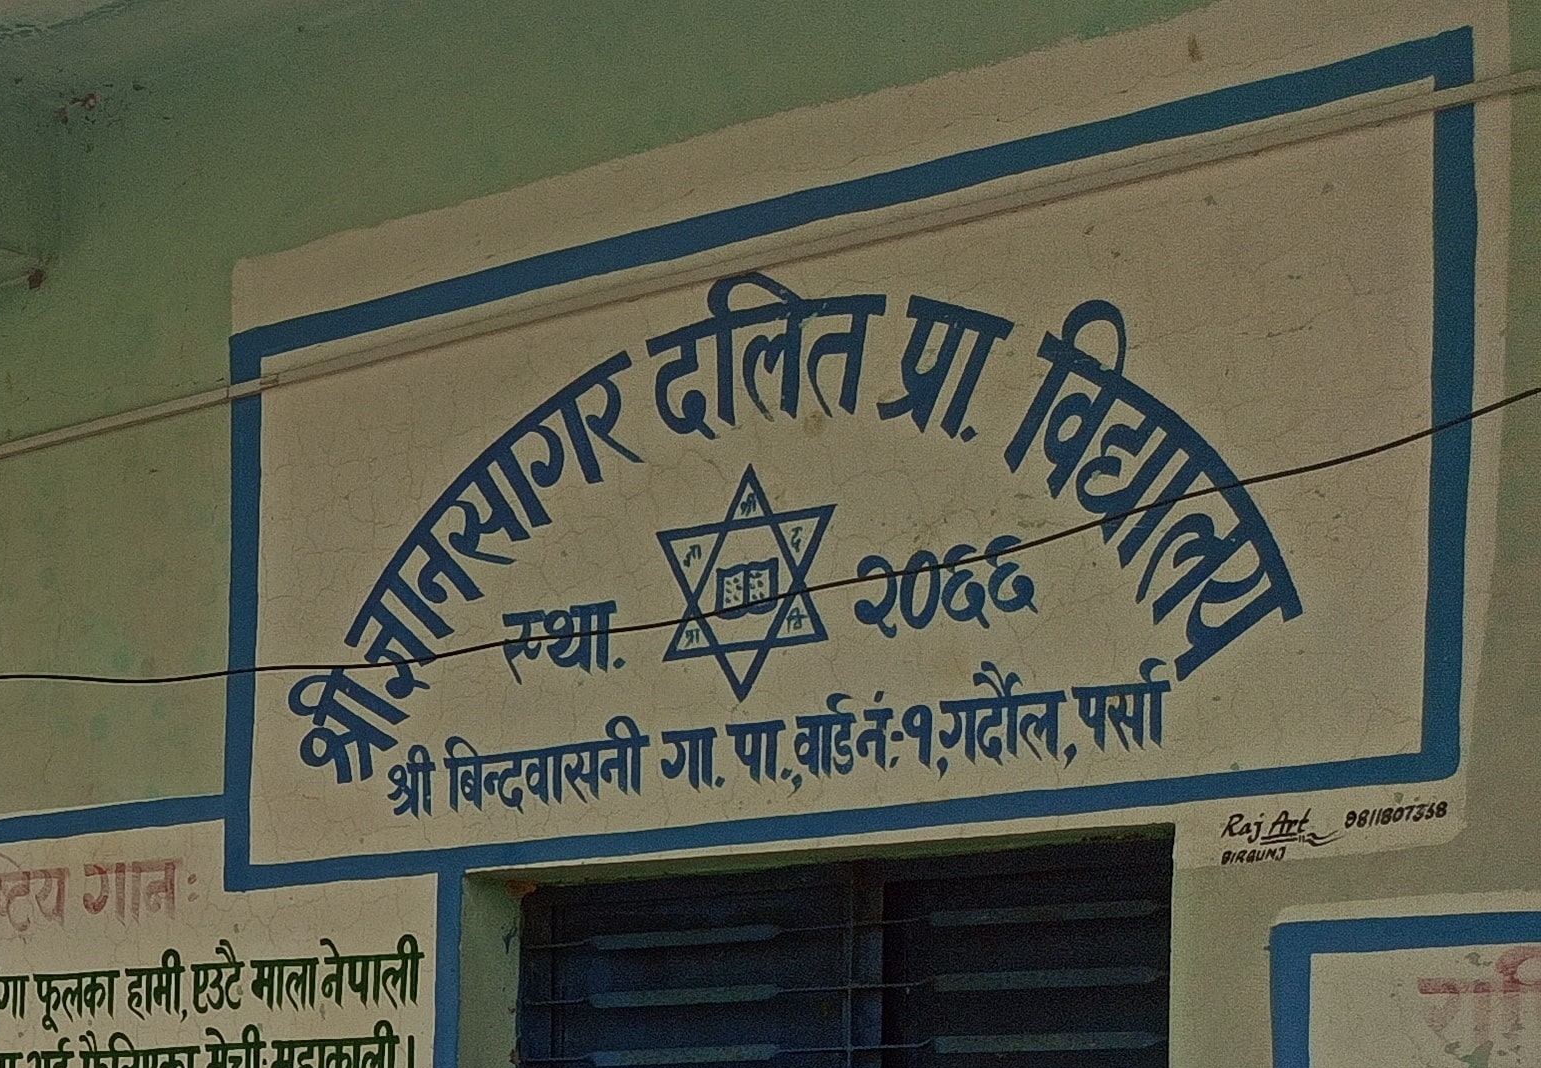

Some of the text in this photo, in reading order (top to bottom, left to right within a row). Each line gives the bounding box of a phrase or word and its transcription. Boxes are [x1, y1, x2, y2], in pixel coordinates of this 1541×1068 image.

[646, 271, 888, 441] दलित
[876, 294, 1016, 444] प्रा.
[1004, 299, 1304, 682] विद्यालय
[502, 535, 1038, 685] स्था. २०६६
[387, 744, 437, 820] श्री
[660, 726, 727, 795] गा.
[1071, 656, 1173, 754] पर्सा
[1220, 811, 1266, 845] Raj
[1267, 807, 1313, 837] Art
[32, 968, 122, 1035] फूलका
[124, 947, 189, 1024] हामी,
[190, 938, 246, 1015] एउटै
[249, 956, 320, 1013] माला
[320, 933, 426, 1011] नेपाली
